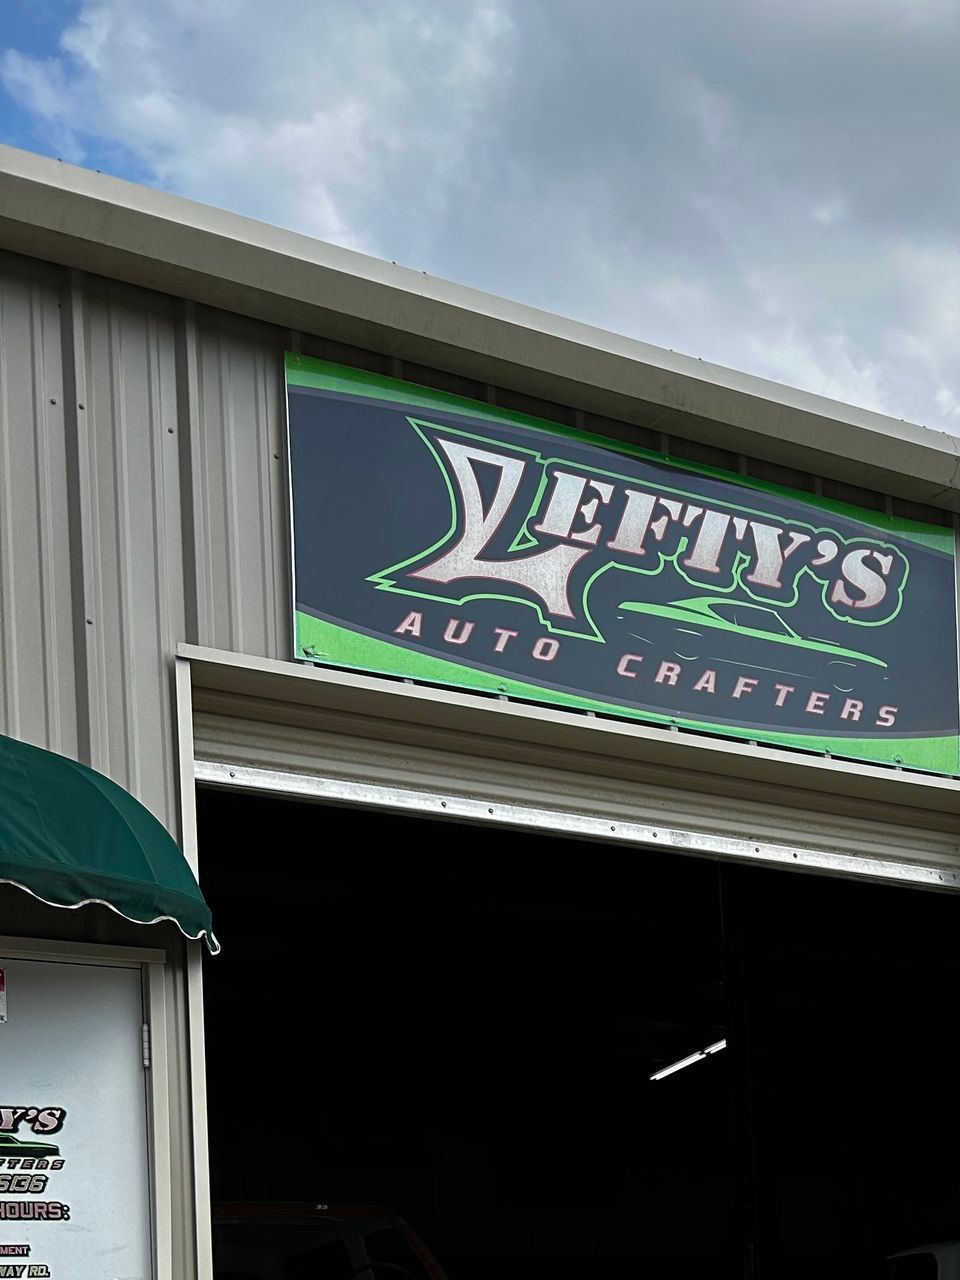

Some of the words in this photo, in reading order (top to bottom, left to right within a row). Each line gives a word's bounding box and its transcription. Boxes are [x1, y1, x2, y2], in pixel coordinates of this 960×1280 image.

[408, 438, 893, 618] LEFTY'S
[395, 611, 561, 662] AUTO
[616, 652, 901, 728] CRAFTERS
[28, 1265, 49, 1278] RD.
